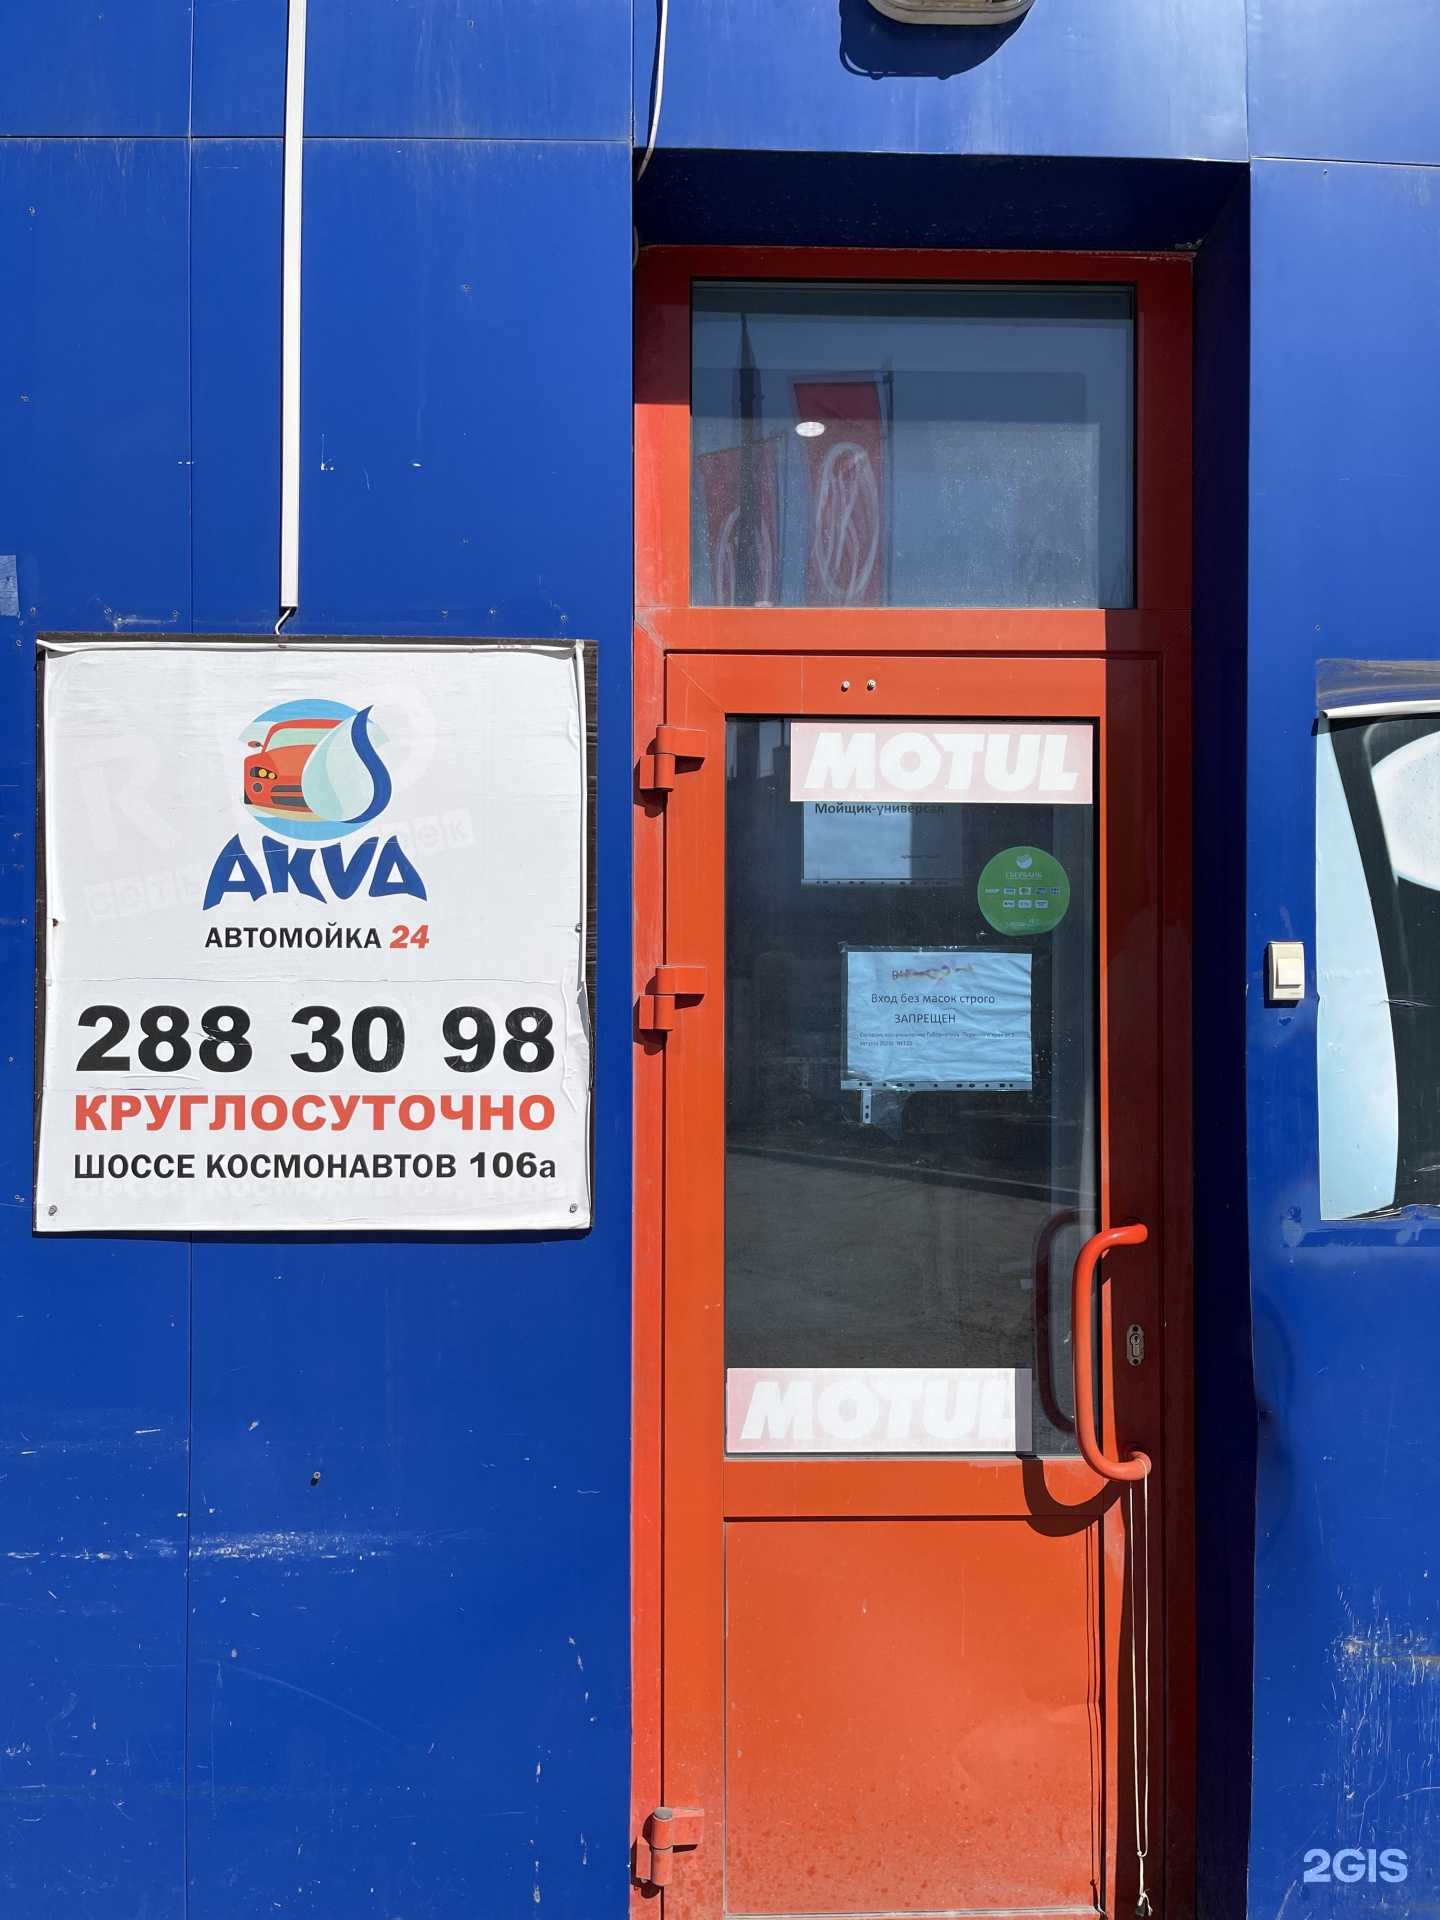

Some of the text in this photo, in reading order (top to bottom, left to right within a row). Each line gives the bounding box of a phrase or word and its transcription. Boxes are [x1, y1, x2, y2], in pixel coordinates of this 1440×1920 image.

[804, 732, 1079, 791] MOTUL
[203, 834, 427, 910] AKVA
[204, 922, 430, 949] АВТОМОЙКА 24
[871, 991, 996, 1006] Вход без масок строго
[894, 1012, 957, 1025] ЗАПРЕЩЕН
[76, 1005, 555, 1073] 288 30 98
[75, 1094, 555, 1131] КРУГЛОСУТОЧНО
[74, 1151, 556, 1179] ШОССЕ КОСМОНАВТОВ 106а
[740, 1380, 1016, 1440] MOTUL
